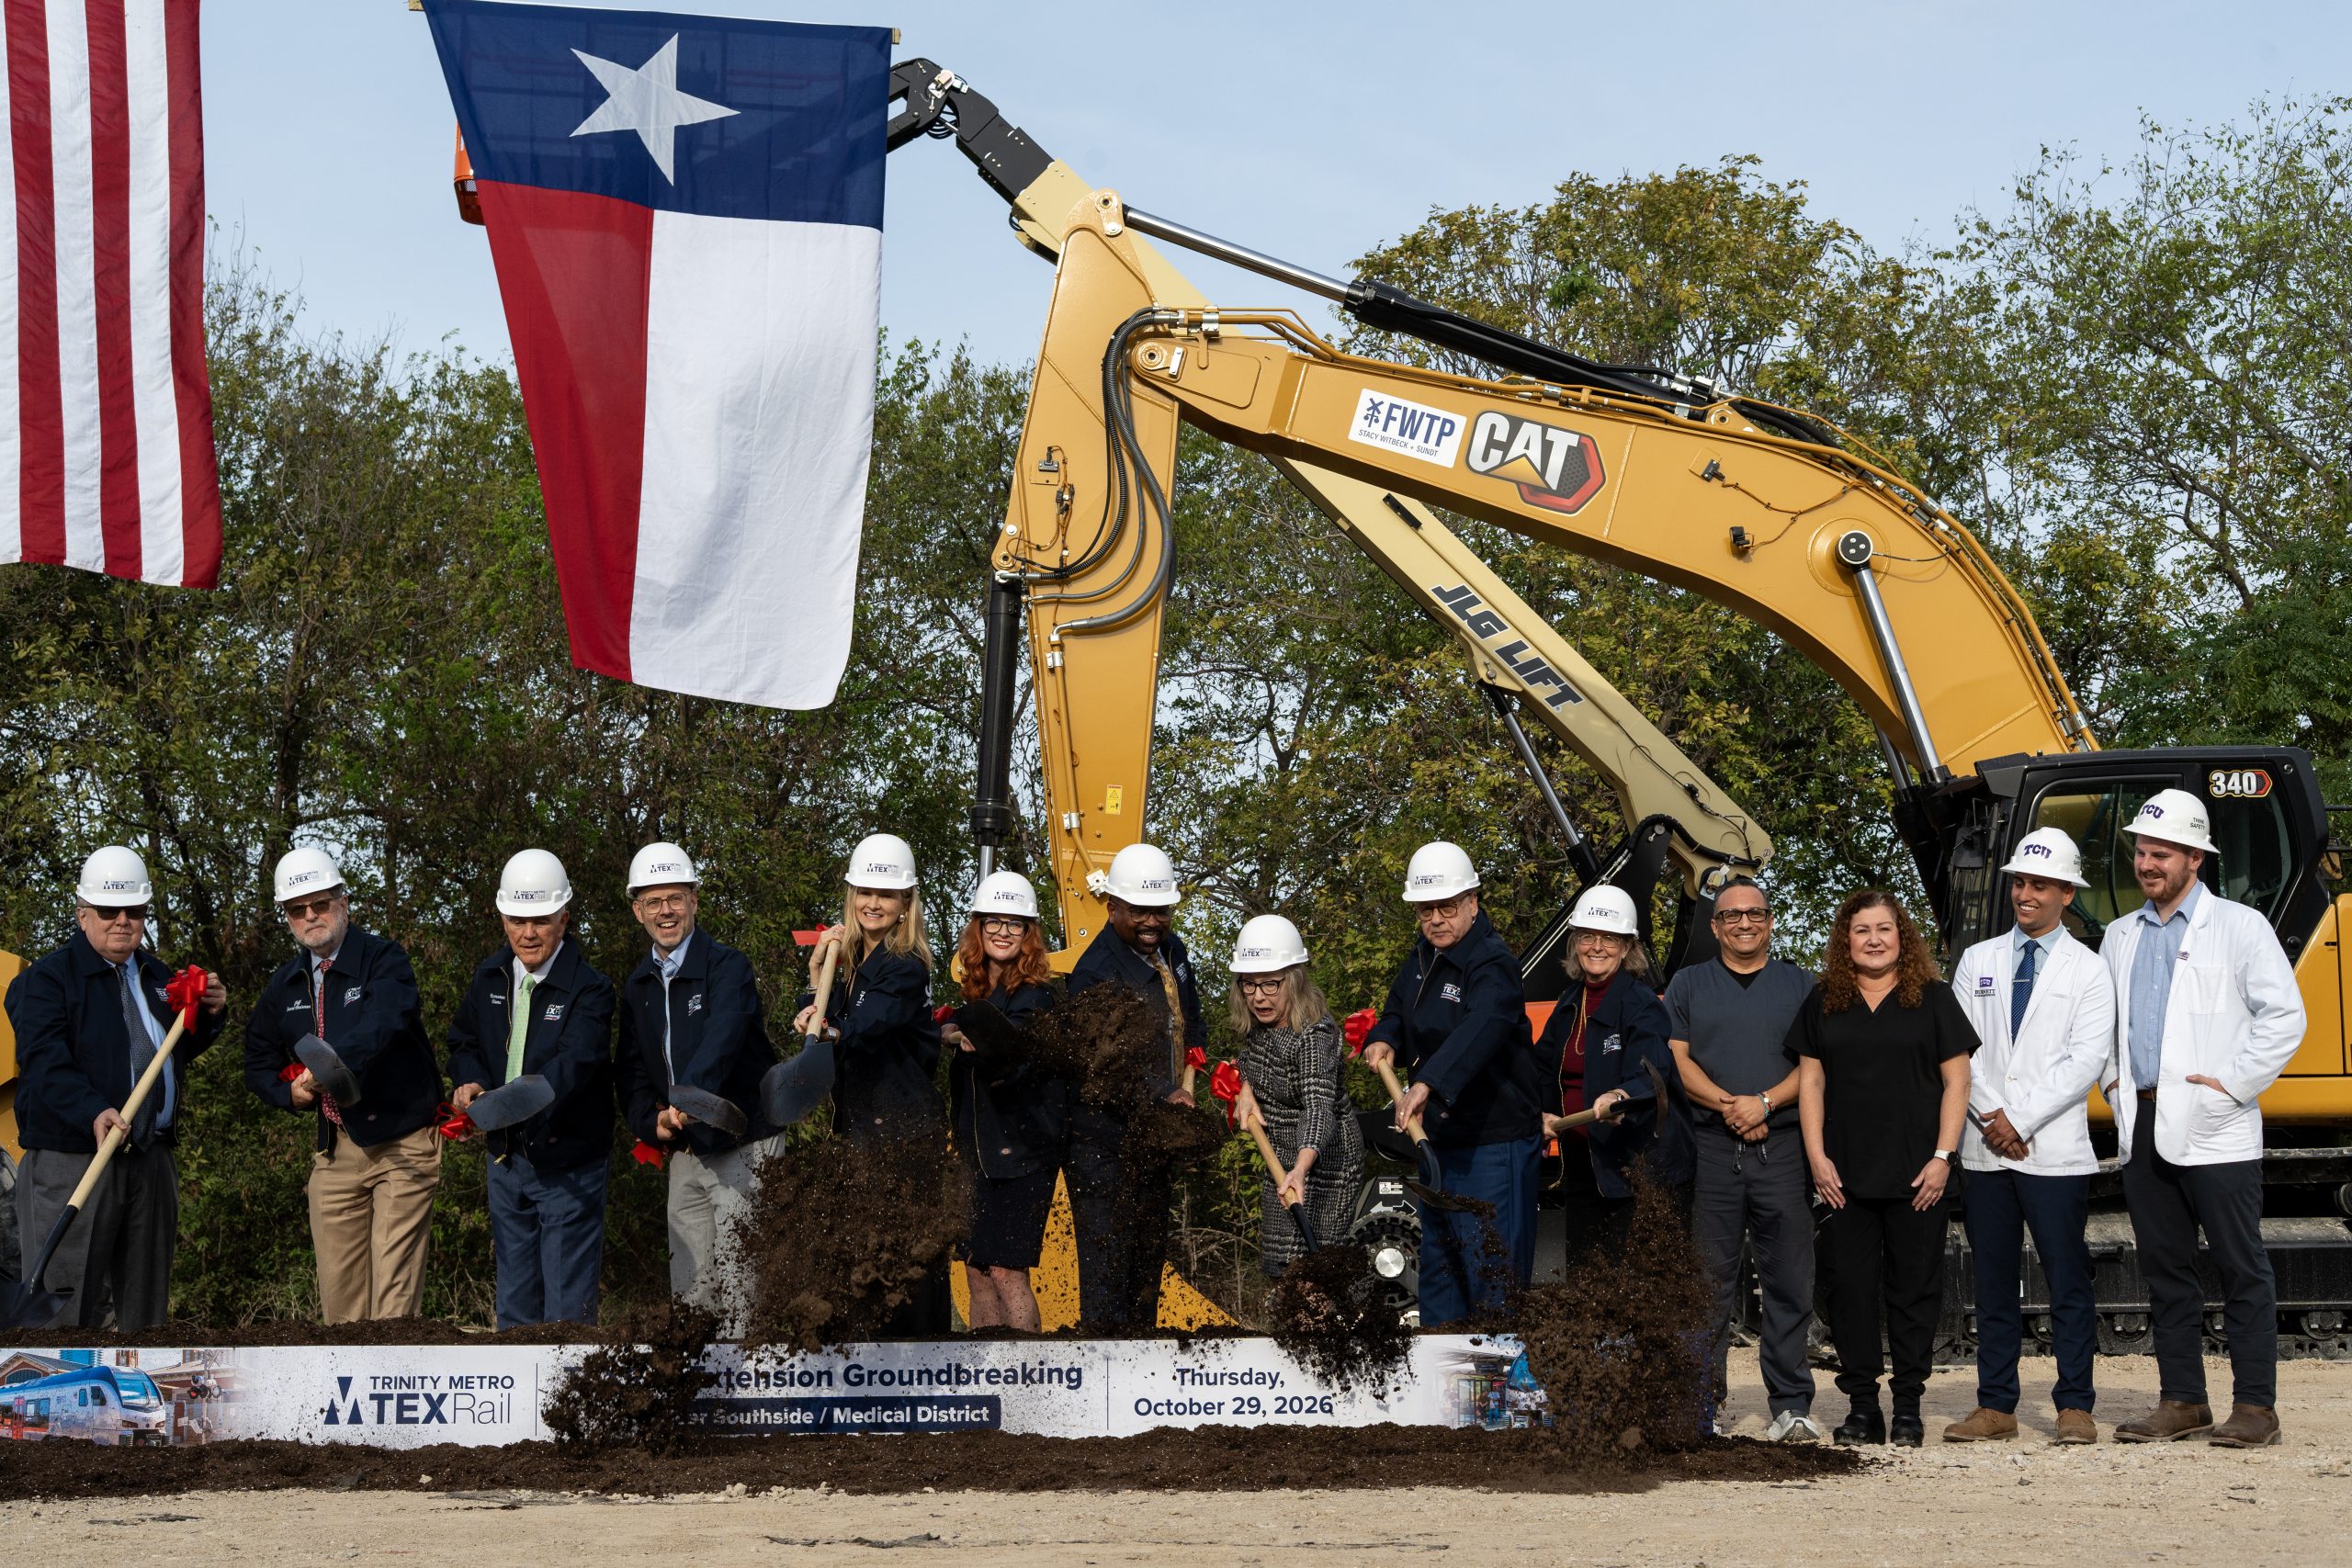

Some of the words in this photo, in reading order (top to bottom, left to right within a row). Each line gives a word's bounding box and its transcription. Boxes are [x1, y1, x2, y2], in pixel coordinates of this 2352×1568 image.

[1381, 402, 1455, 447] FWTP
[1359, 429, 1379, 441] STACY
[1380, 434, 1408, 448] WITBECK
[1417, 446, 1438, 457] SUNDT
[1468, 412, 1580, 491] CAT
[1430, 583, 1510, 640] JLG
[1494, 639, 1584, 707] LIFT
[2212, 773, 2257, 795] 340
[2140, 804, 2165, 819] TCU
[2024, 844, 2052, 859] TCU
[369, 1376, 441, 1390] TRINITY
[449, 1375, 514, 1390] METRO
[842, 1361, 1082, 1391] Groundbreaking
[1177, 1368, 1284, 1388] Thursday,
[369, 1393, 512, 1425] TEXRail
[714, 1407, 814, 1425] Southside
[833, 1406, 910, 1424] Medical
[918, 1405, 989, 1423] District
[1135, 1397, 1225, 1416] October
[1232, 1396, 1267, 1417] 29,
[1274, 1395, 1333, 1415] 2026
